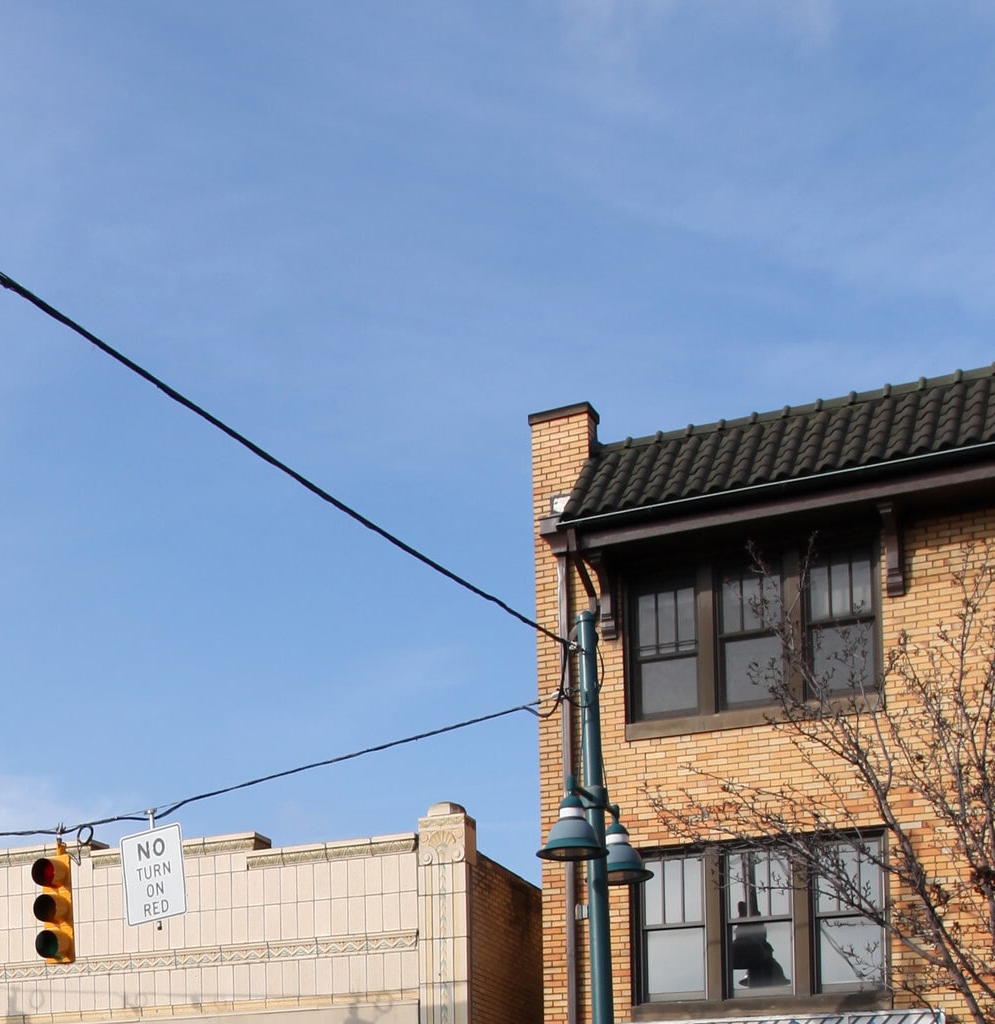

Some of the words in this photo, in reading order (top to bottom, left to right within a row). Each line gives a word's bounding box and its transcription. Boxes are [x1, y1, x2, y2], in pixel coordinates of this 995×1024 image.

[137, 838, 165, 861] NO
[136, 860, 172, 882] TURN
[146, 881, 165, 898] ON
[143, 899, 170, 918] RED
